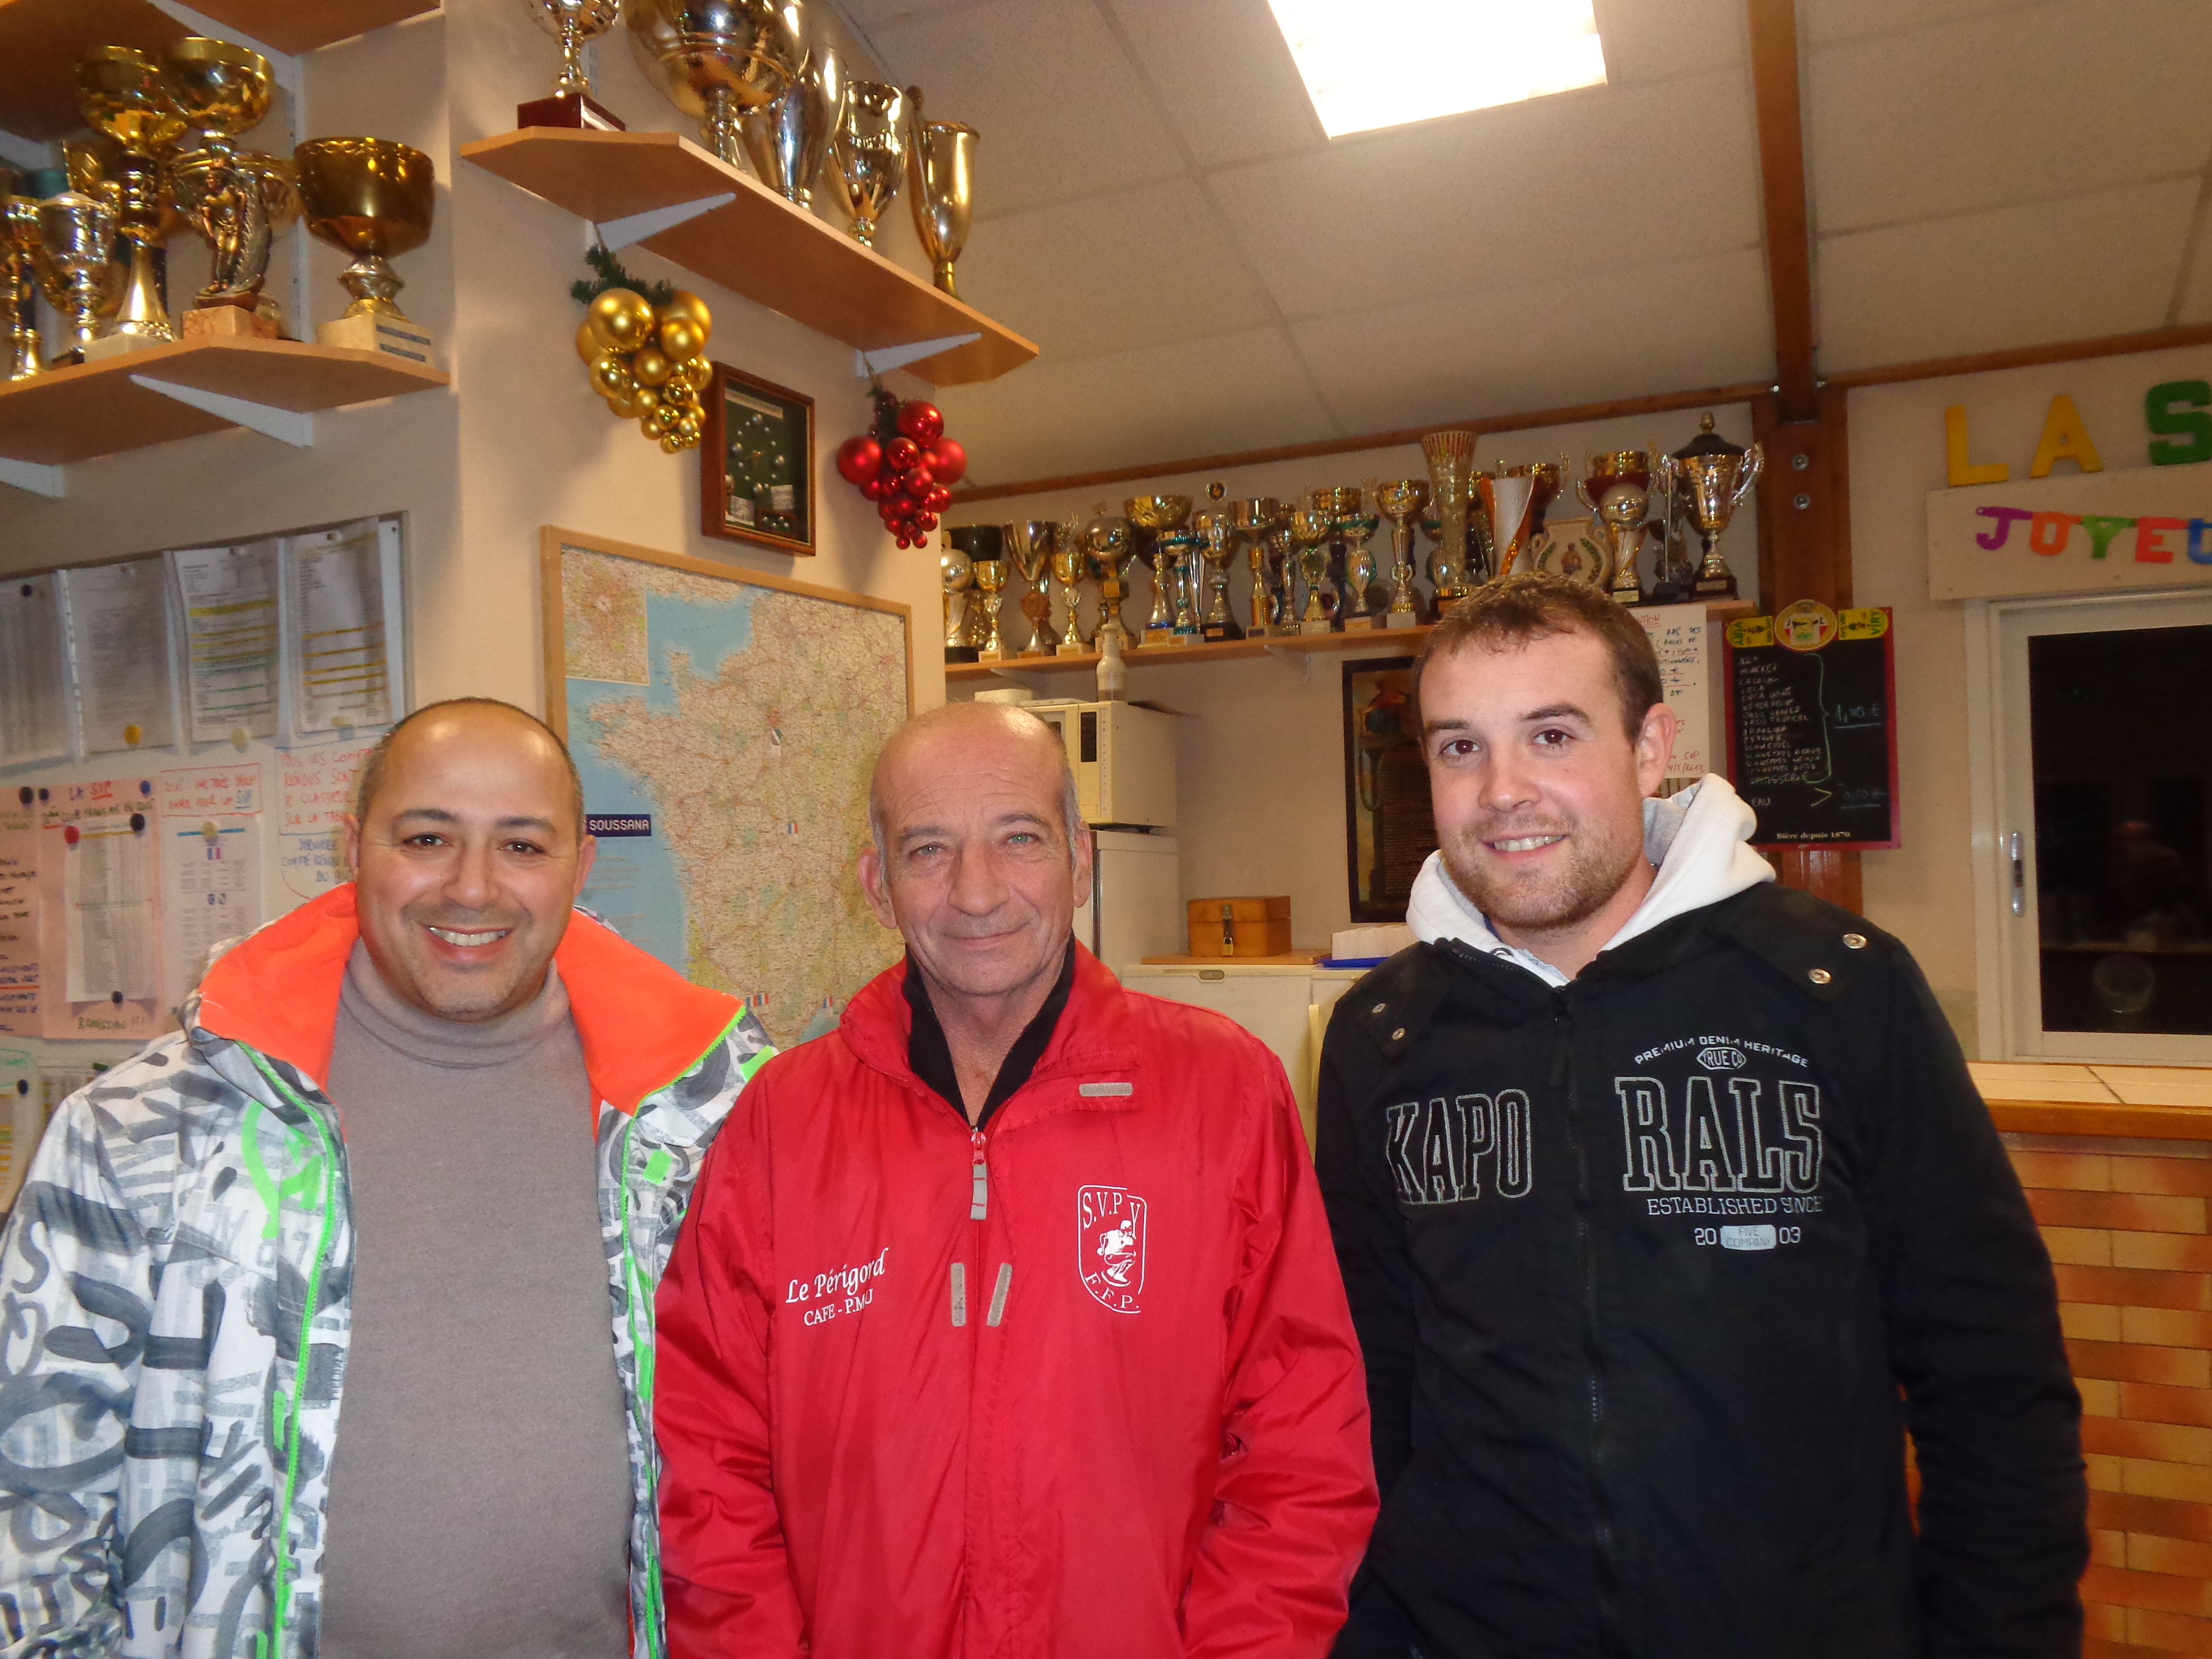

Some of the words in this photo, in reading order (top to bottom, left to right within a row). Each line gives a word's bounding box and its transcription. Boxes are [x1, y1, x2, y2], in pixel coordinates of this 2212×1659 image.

[1945, 395, 2104, 487] LA
[589, 819, 649, 831] SOUSSANA
[1635, 1037, 1695, 1064] PREMIUM
[1699, 1035, 1741, 1046] DENIM
[1743, 1040, 1809, 1068] HERITAGE
[1702, 1049, 1730, 1067] TRUE
[1614, 1076, 1823, 1193] RALS
[1386, 1088, 1532, 1205] KAPO
[1647, 1197, 1777, 1215] ESTABLISHED
[1781, 1196, 1823, 1214] SINCE
[1694, 1227, 1717, 1246] 20
[1779, 1226, 1801, 1244] 03
[1726, 1236, 1772, 1248] COMPANY
[1738, 1226, 1760, 1237] FIVE
[785, 1279, 809, 1303] Le
[813, 1247, 890, 1298] Périgord
[804, 1303, 835, 1326] CAFE
